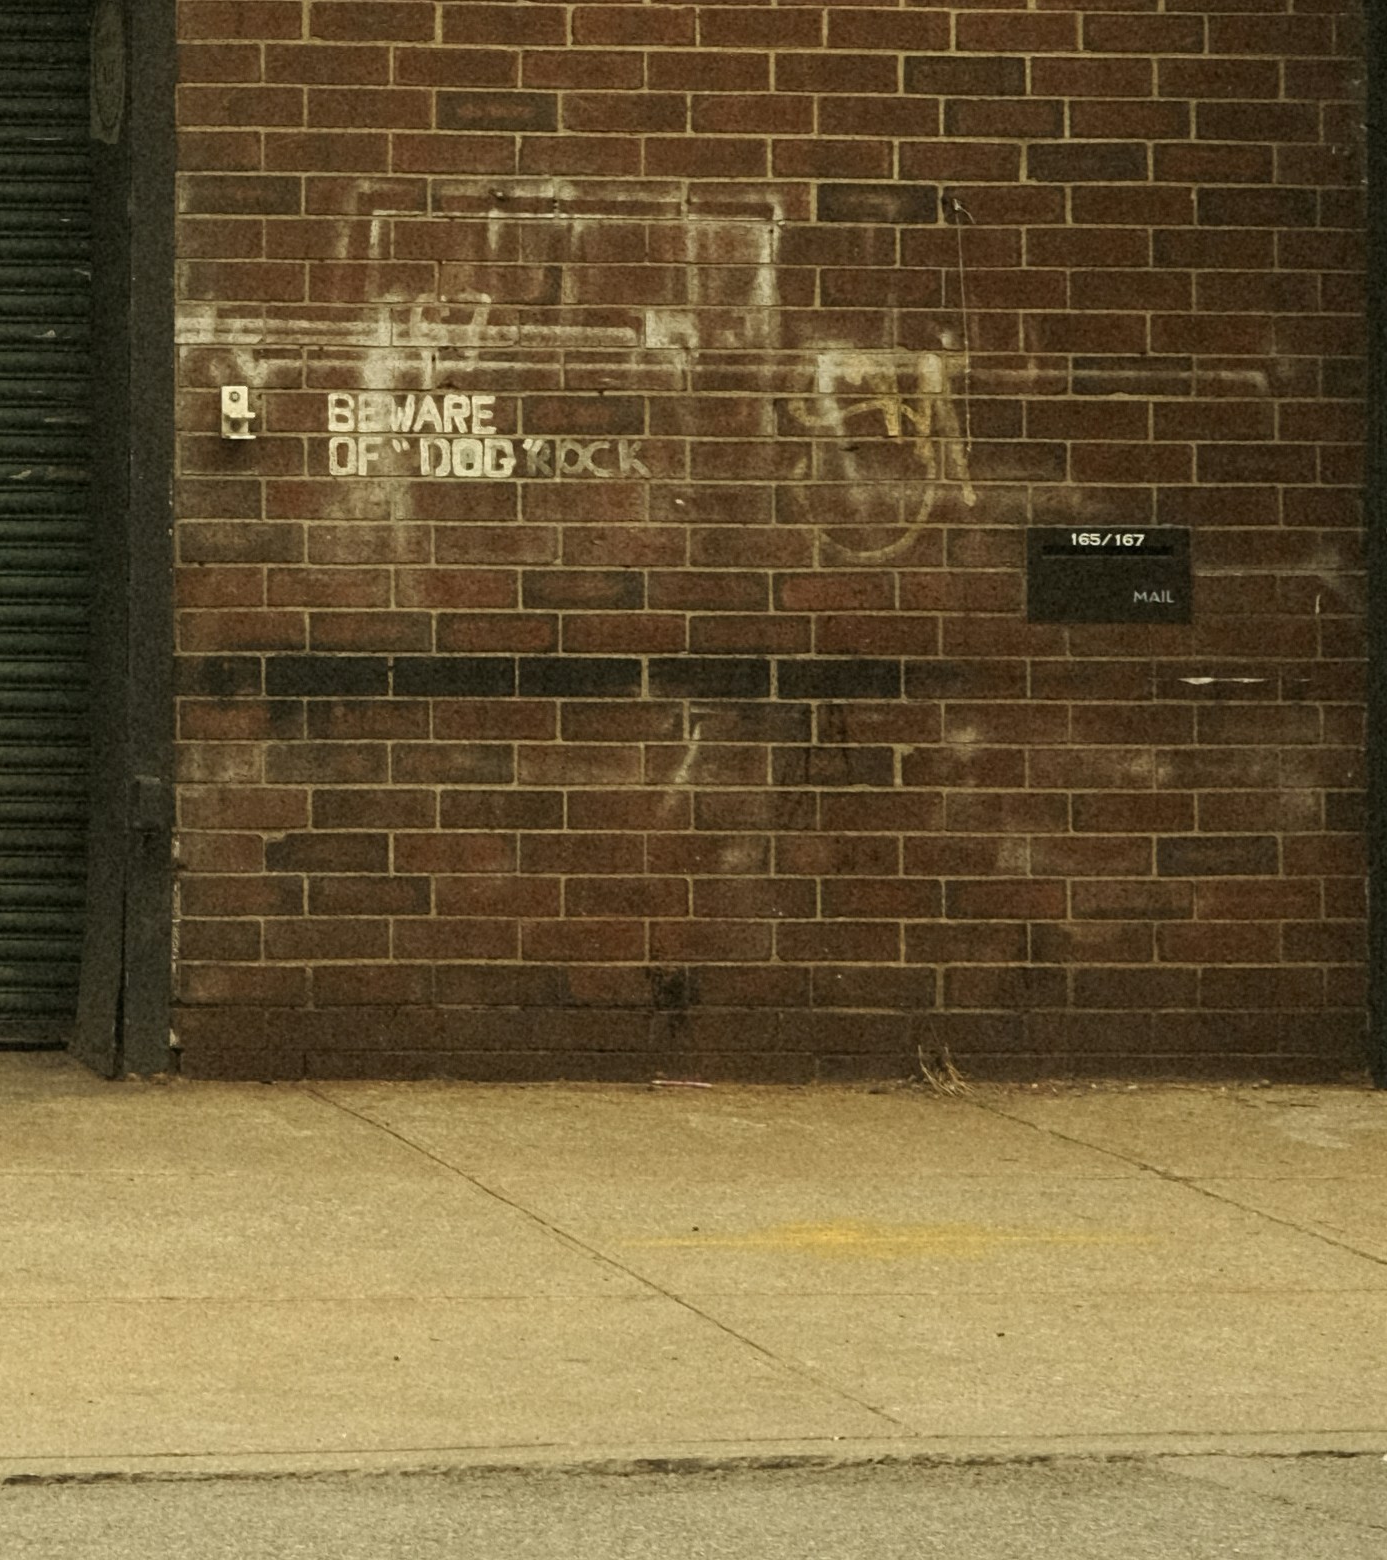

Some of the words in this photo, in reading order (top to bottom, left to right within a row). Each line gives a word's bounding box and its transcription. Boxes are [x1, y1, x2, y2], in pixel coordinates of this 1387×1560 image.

[327, 391, 497, 435] BEWARE
[328, 435, 383, 476] OF
[1071, 533, 1145, 546] 165/167
[1133, 590, 1174, 603] MAIL
